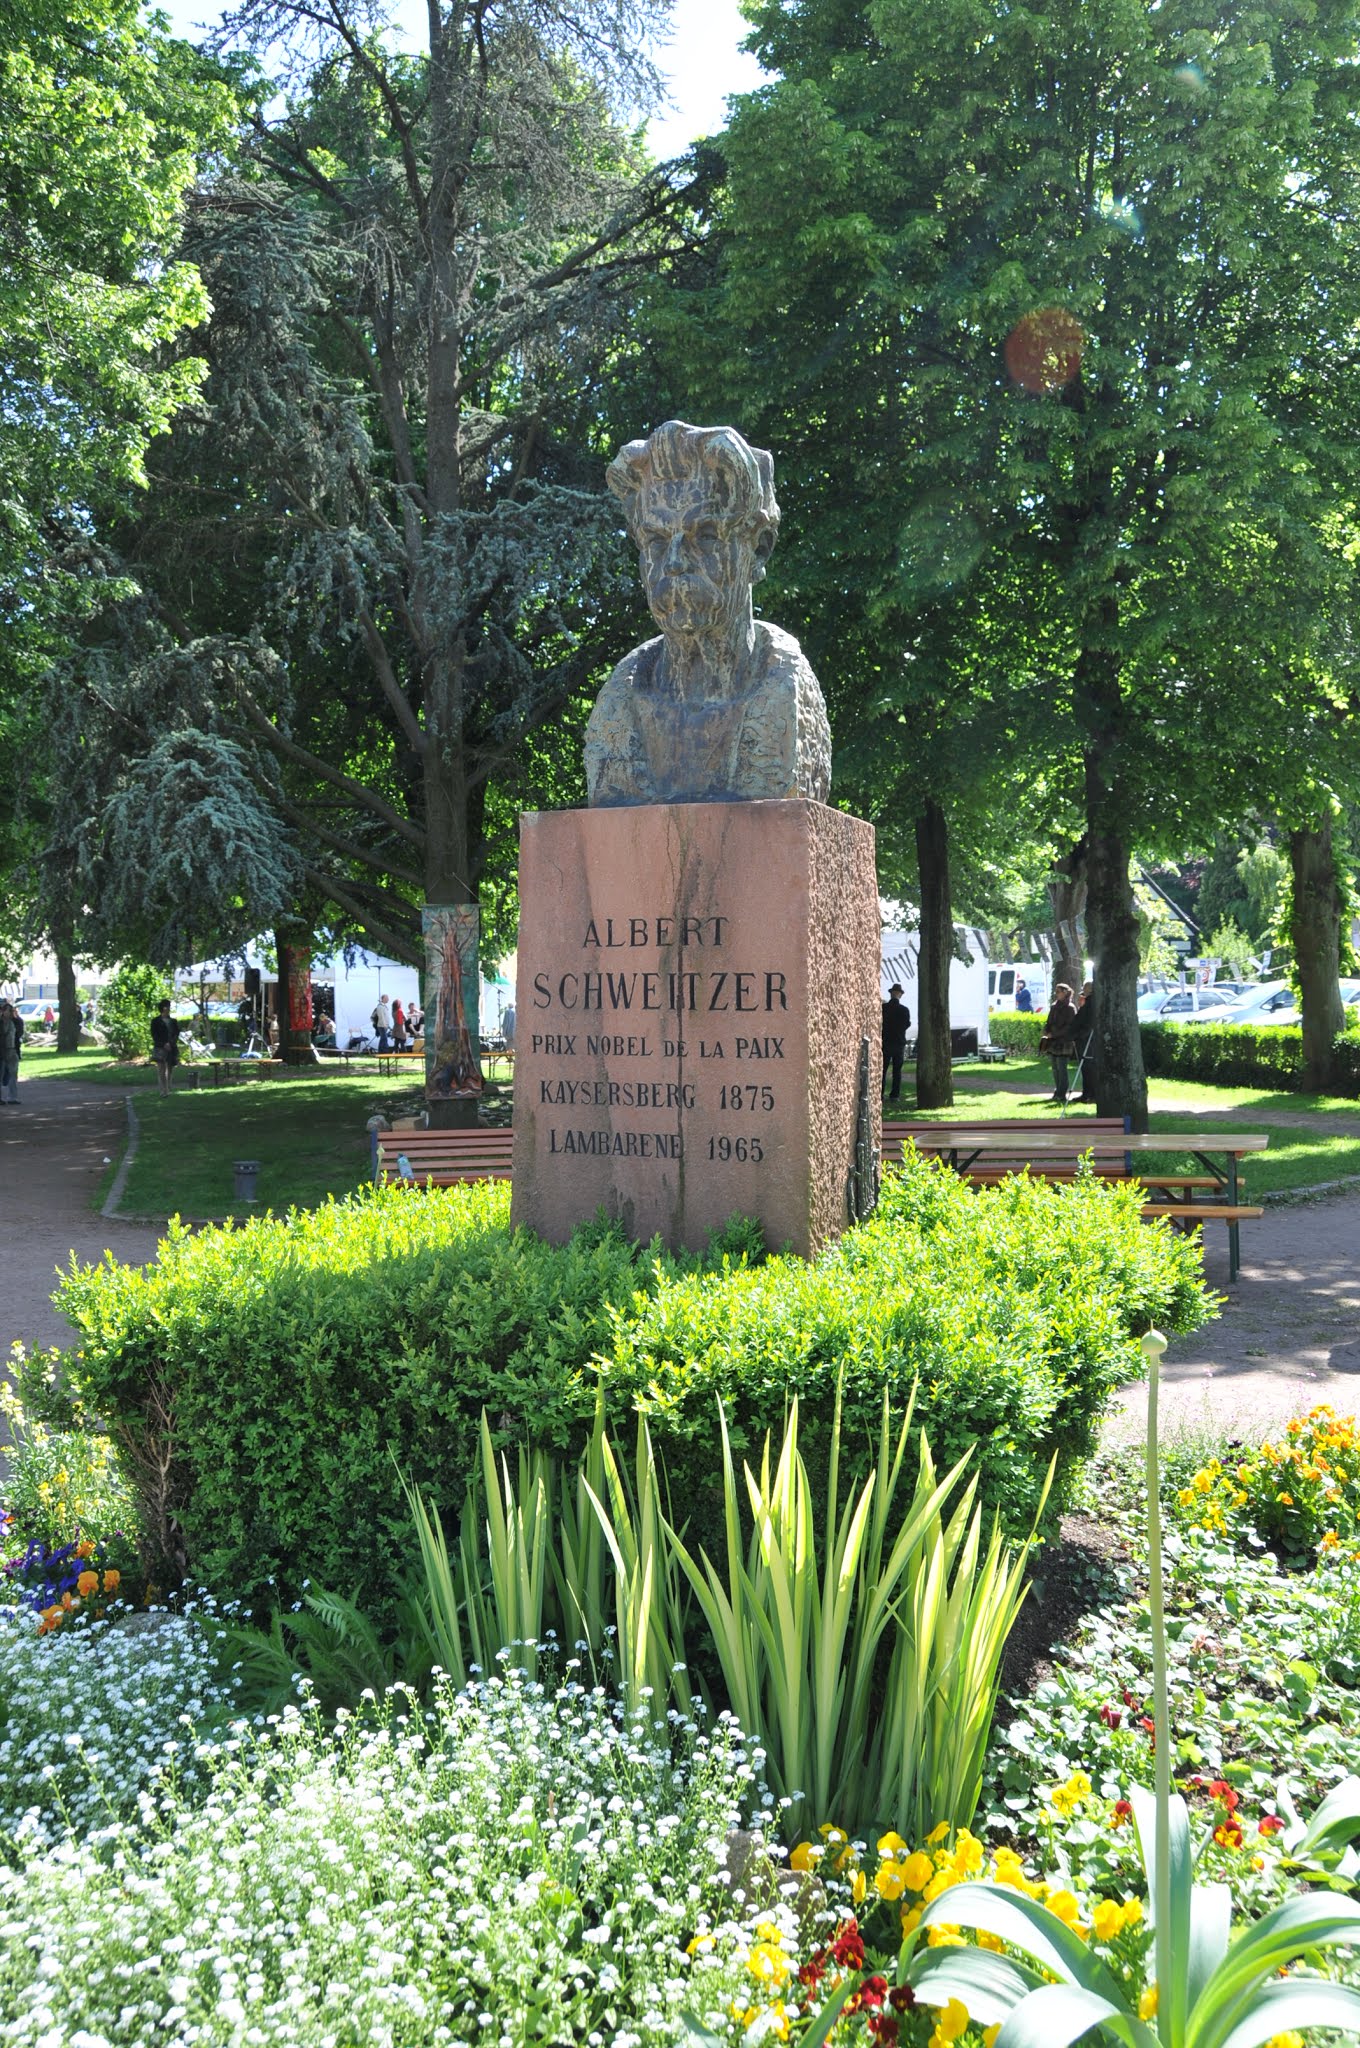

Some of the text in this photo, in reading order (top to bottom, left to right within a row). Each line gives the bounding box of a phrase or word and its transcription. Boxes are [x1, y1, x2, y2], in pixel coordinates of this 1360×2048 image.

[583, 917, 729, 948] ALBERT
[533, 972, 788, 1011] SCHWEITZER
[532, 1035, 785, 1059] PRIX NOBEL DE LA PAIX
[540, 1080, 775, 1111] KAYSERSBERG 1875
[550, 1129, 764, 1162] LAMBARENE 1965
